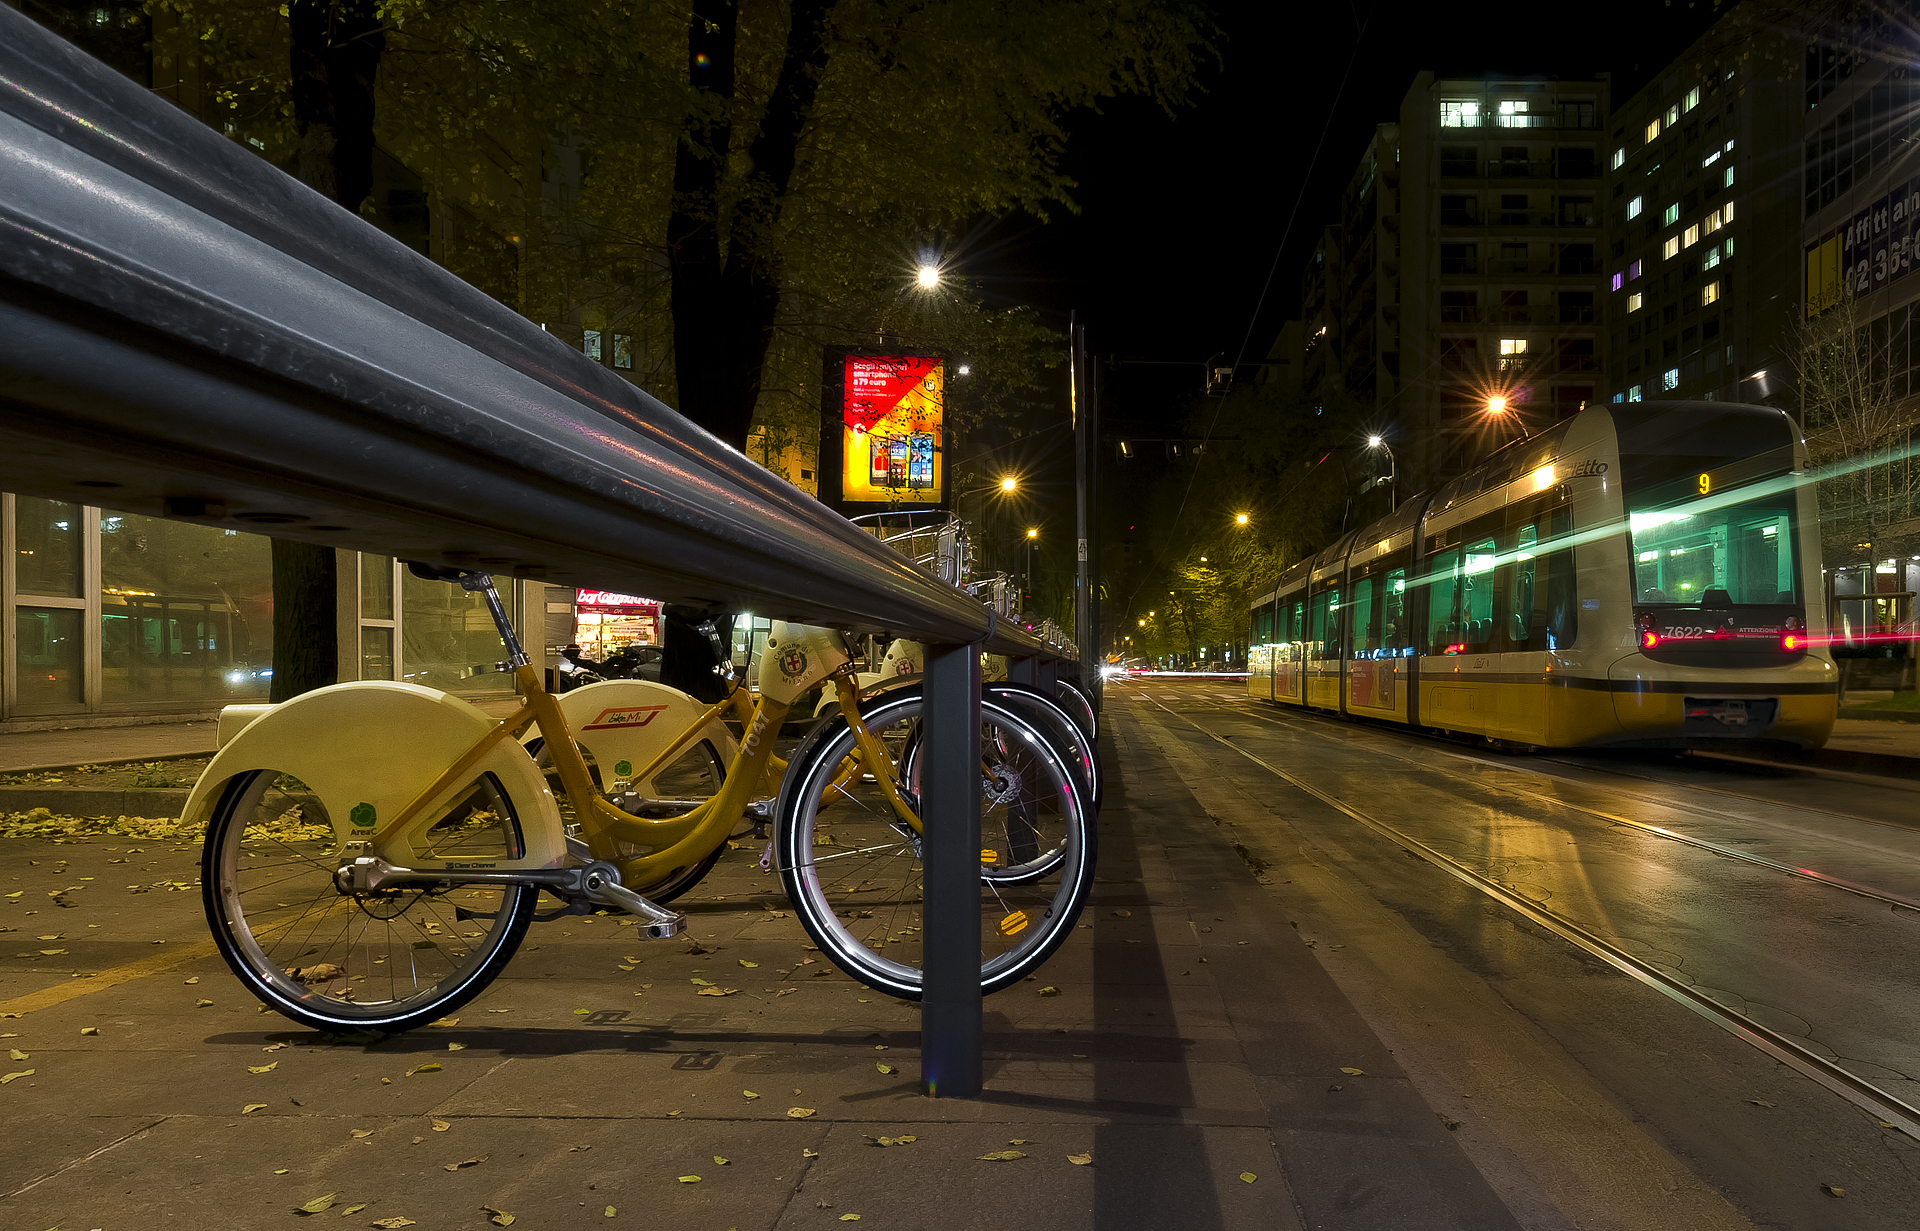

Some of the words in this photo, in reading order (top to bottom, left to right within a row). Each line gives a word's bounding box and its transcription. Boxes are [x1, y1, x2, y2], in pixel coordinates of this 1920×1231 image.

[853, 371, 897, 379] smartphone
[859, 378, 868, 386] 79
[1699, 473, 1710, 494] 9
[1664, 626, 1703, 639] 7622
[774, 642, 800, 661] Comune
[801, 643, 809, 654] di
[782, 670, 813, 685] Milano
[740, 709, 770, 757] 7047
